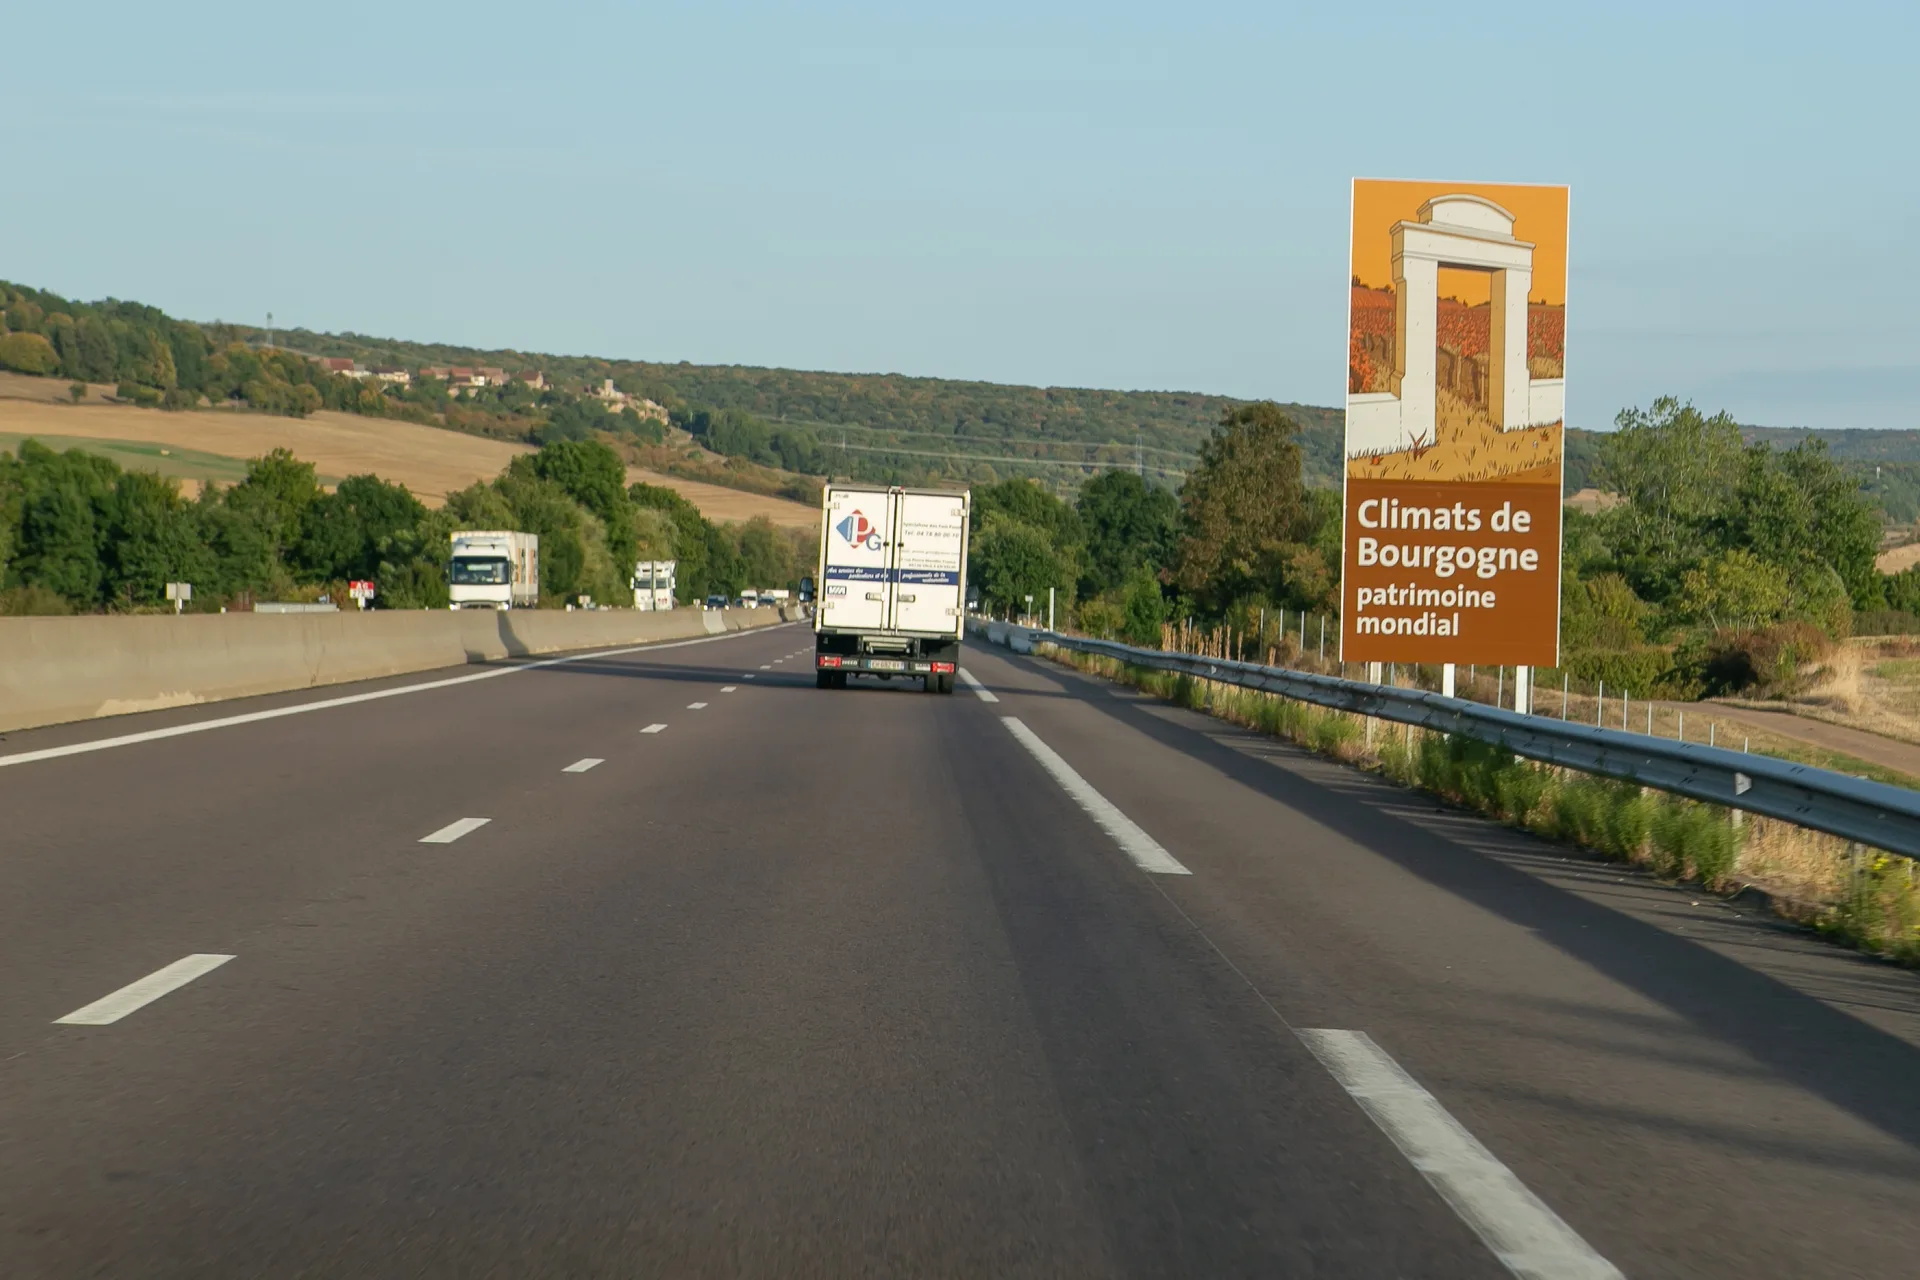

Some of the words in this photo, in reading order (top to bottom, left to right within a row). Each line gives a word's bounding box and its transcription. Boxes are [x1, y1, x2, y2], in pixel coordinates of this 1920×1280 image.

[1357, 497, 1482, 532] Climats
[1490, 501, 1531, 533] de
[1358, 537, 1539, 579] Bourgogne
[1357, 582, 1496, 612] patrimoine
[1356, 612, 1459, 636] mondial
